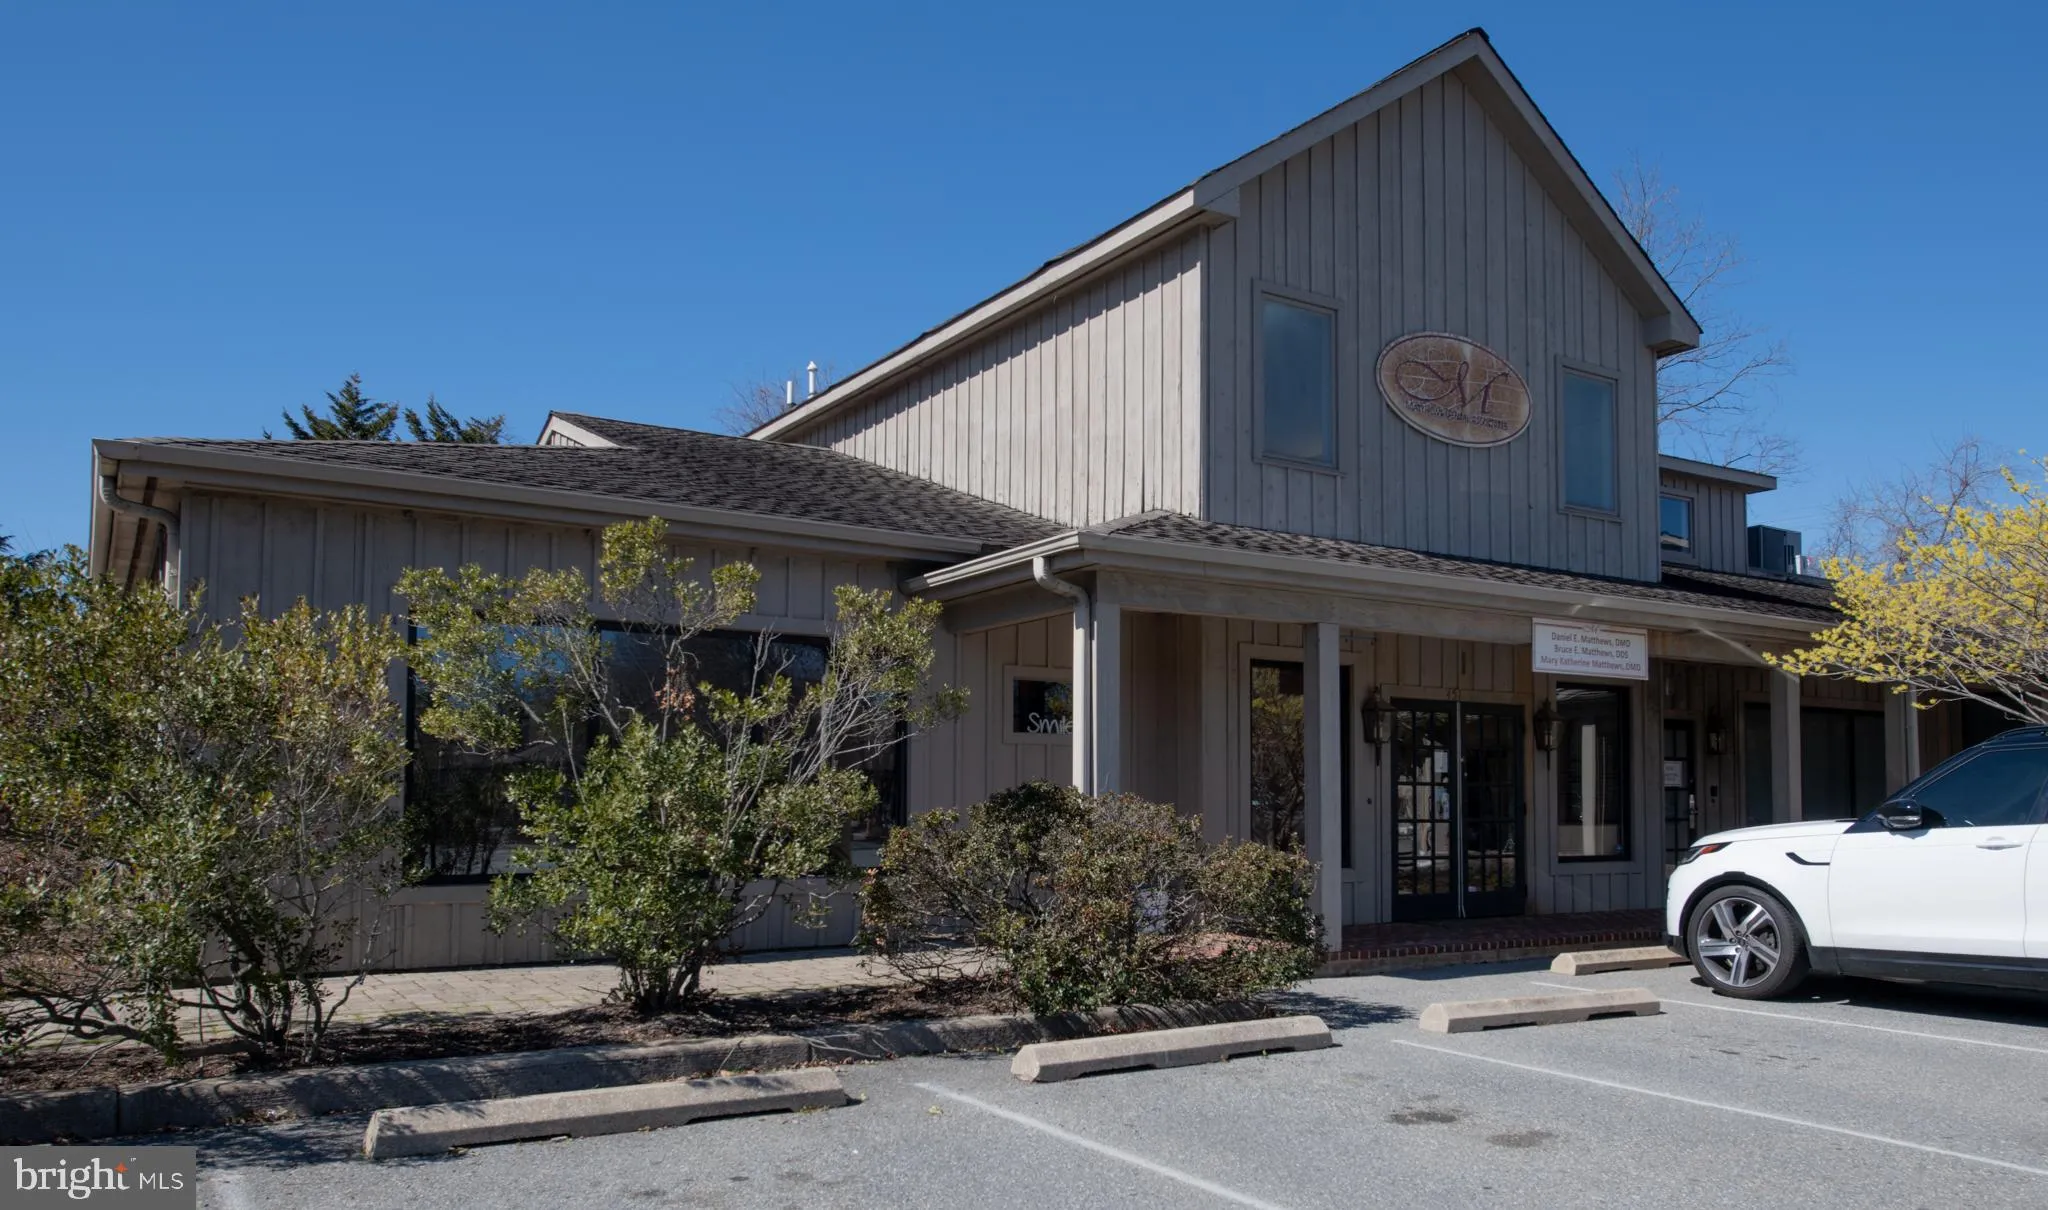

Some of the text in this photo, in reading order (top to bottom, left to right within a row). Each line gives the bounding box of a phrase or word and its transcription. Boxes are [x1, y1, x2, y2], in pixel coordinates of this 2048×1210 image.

[1551, 632, 1573, 641] Daniel
[1581, 635, 1613, 647] Matthews,
[1615, 638, 1631, 647] DMD
[1554, 644, 1573, 654] Bruce
[1581, 647, 1615, 659] Matthews,
[1616, 650, 1629, 659] DDS
[1540, 656, 1558, 666] Mary
[1626, 662, 1641, 672] DMD
